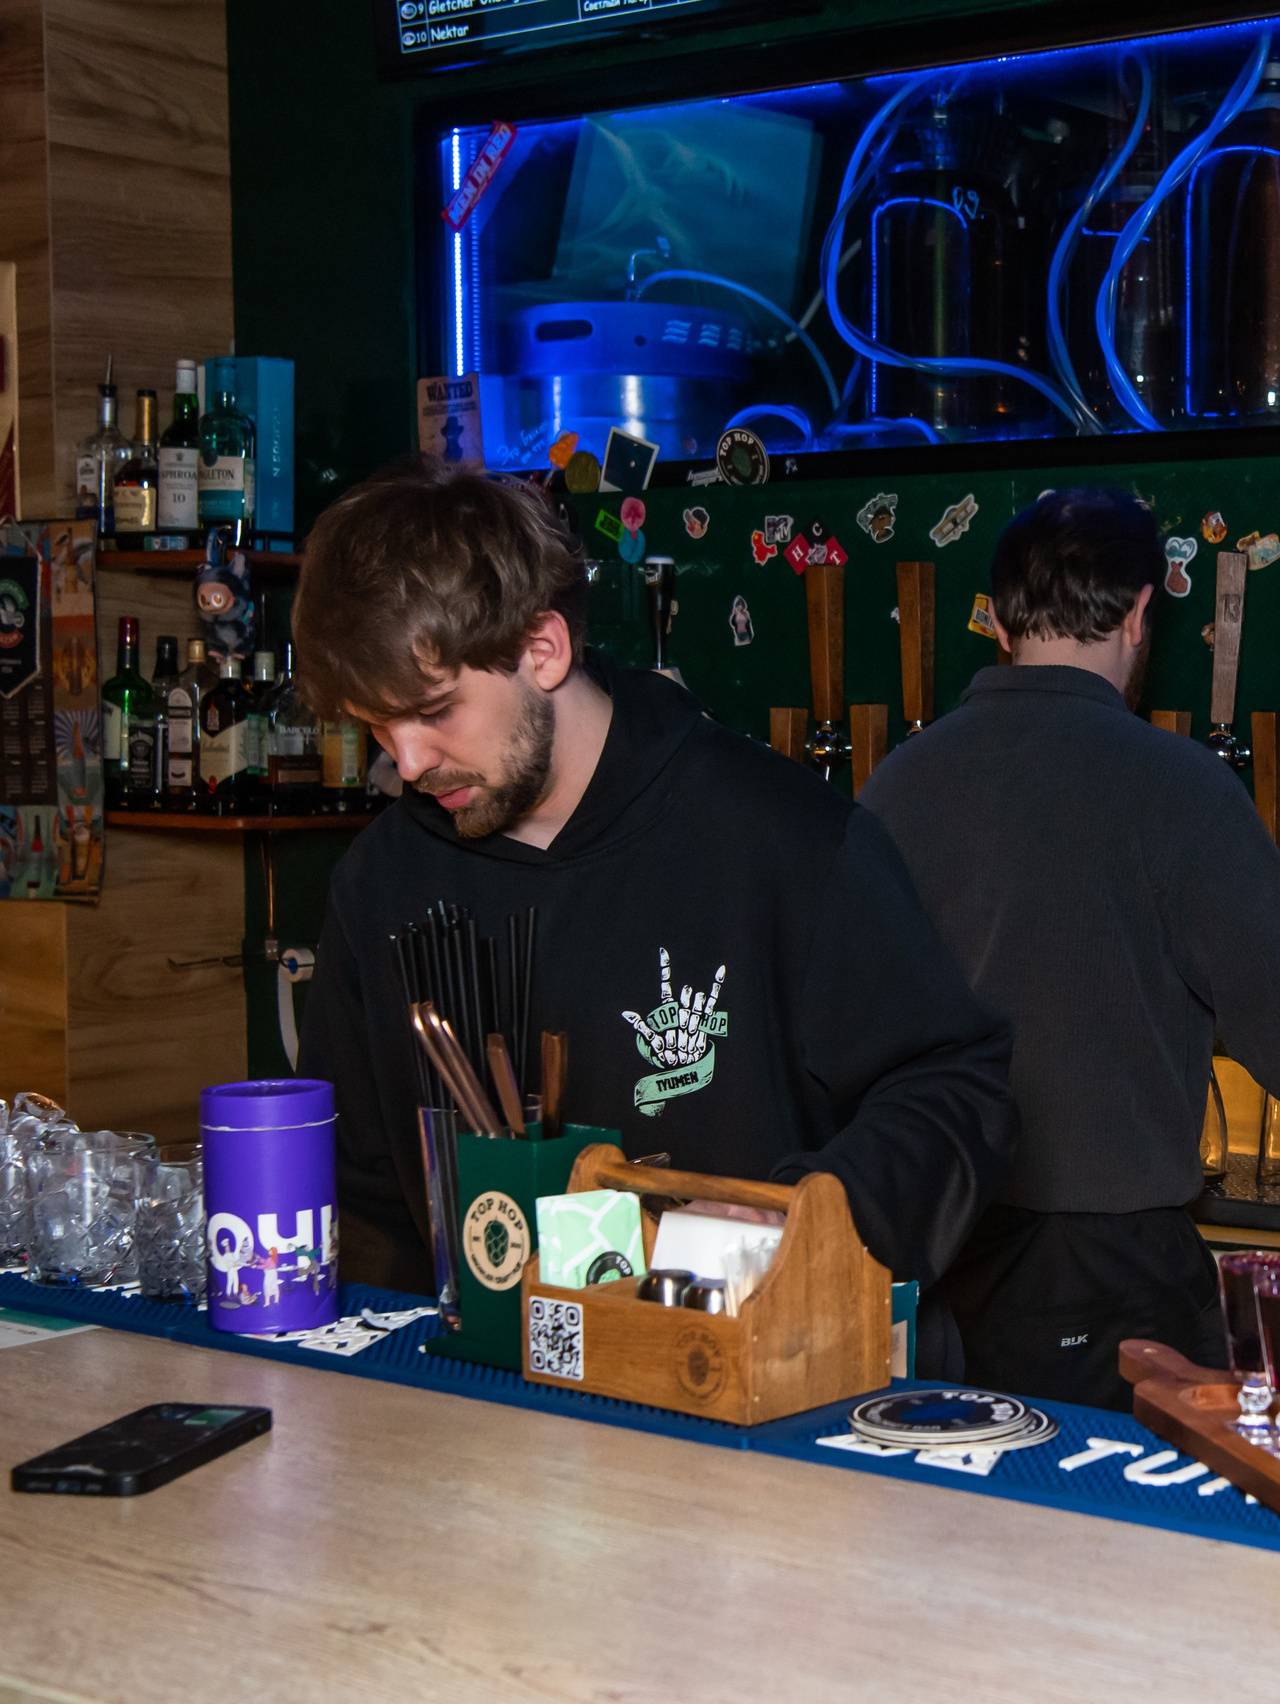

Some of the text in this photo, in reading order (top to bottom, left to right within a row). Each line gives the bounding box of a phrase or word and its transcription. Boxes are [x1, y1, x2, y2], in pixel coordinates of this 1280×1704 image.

[418, 3, 424, 15] 9
[416, 24, 469, 43] 10 Nektar
[427, 380, 473, 402] WANTED
[720, 432, 755, 456] TOP HOP
[172, 492, 186, 504] 10
[651, 1006, 727, 1033] TOP HOP
[656, 1071, 700, 1092] TYUMEN
[471, 1198, 523, 1230] TOP HOP
[615, 1256, 631, 1276] TOP
[1061, 1334, 1089, 1347] BLK
[942, 1392, 996, 1403] TOP
